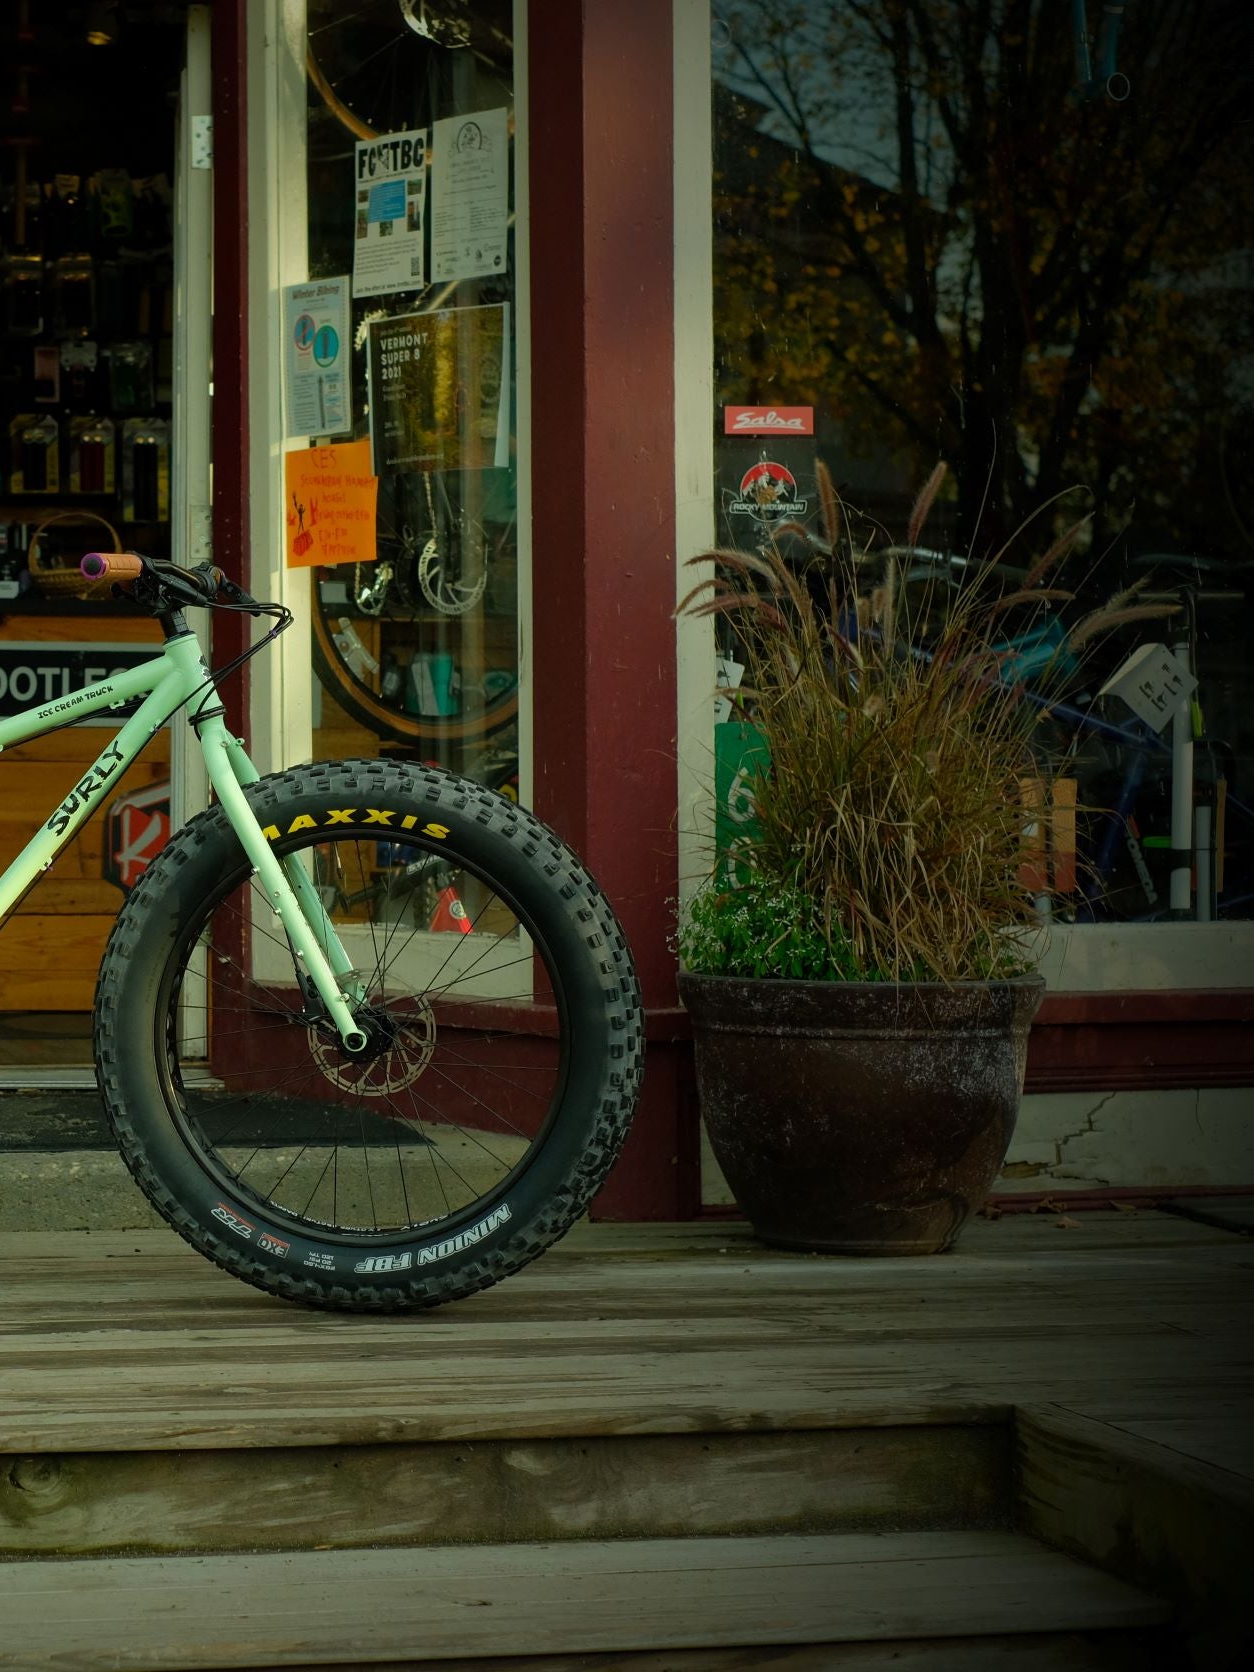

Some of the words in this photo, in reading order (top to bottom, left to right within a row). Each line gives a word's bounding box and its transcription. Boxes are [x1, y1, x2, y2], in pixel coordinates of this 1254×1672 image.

[380, 333, 428, 351] VERMONT
[380, 351, 410, 366] SUPER
[413, 349, 421, 360] 8
[381, 367, 402, 380] 2021
[733, 411, 806, 430] Salsa
[733, 503, 758, 511] ROCKY
[36, 707, 54, 718] ICE
[54, 696, 84, 711] CREAM
[84, 685, 114, 700] TRUCK
[46, 739, 124, 837] SURLY
[418, 1203, 512, 1266] MINION
[260, 1240, 285, 1257] EXO
[354, 1251, 412, 1273] FBF
